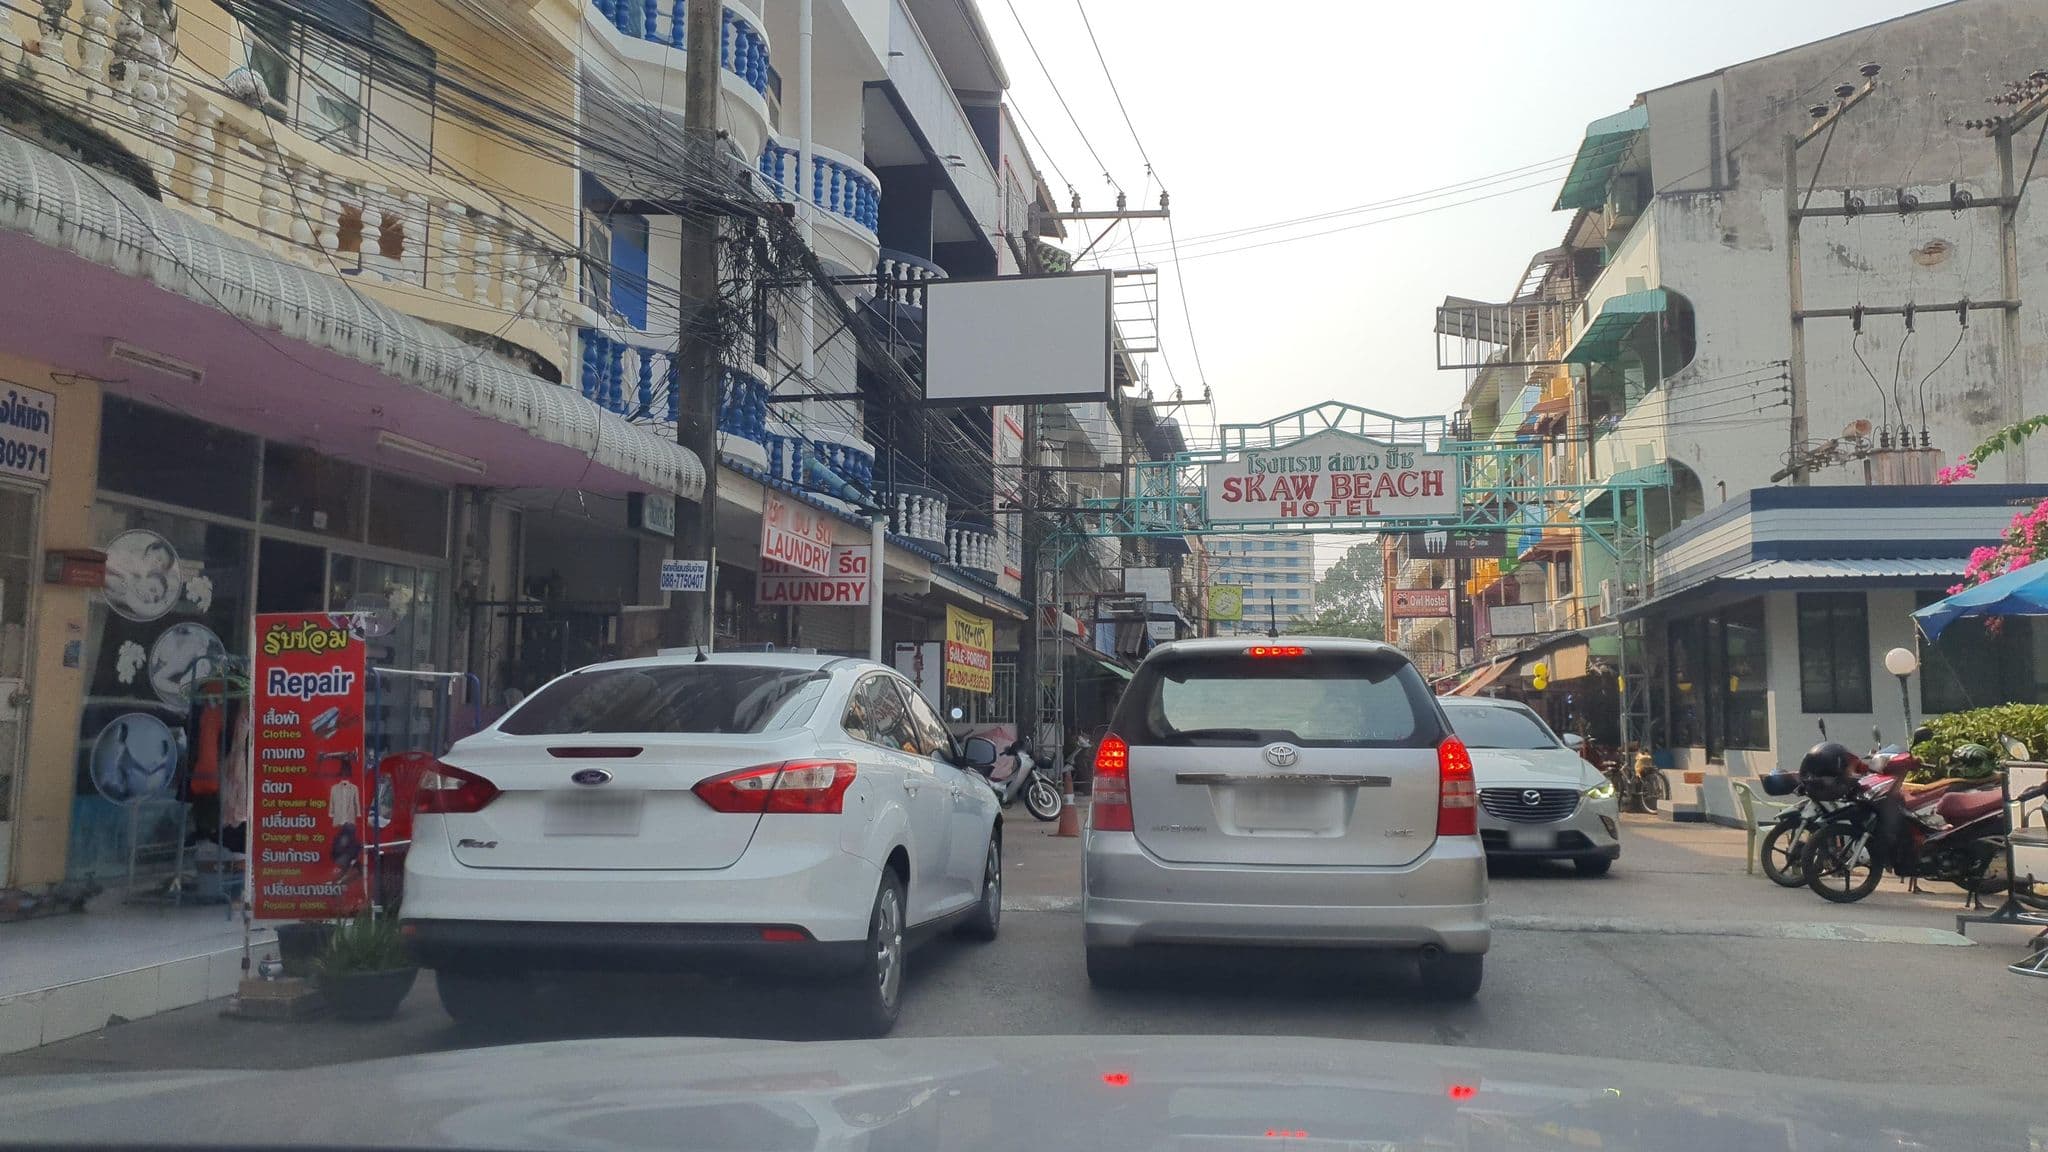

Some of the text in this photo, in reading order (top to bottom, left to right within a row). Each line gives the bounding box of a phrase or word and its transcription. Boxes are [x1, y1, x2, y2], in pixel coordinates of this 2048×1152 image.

[1246, 452, 1322, 475] โรงแรม
[1386, 447, 1415, 470] บีช
[1222, 470, 1444, 503] SKAW BEACH
[1280, 500, 1381, 517] HOTEL
[765, 528, 830, 574] LAUNDRY
[838, 550, 867, 574] รีด
[760, 581, 866, 603] LAUNDRY
[1425, 594, 1448, 607] Hostel
[268, 666, 355, 701] Repair
[262, 707, 300, 725] เสื้อผ้า
[262, 729, 302, 739] Clothes
[261, 748, 306, 760] กางเกง
[262, 764, 308, 774] Trousers
